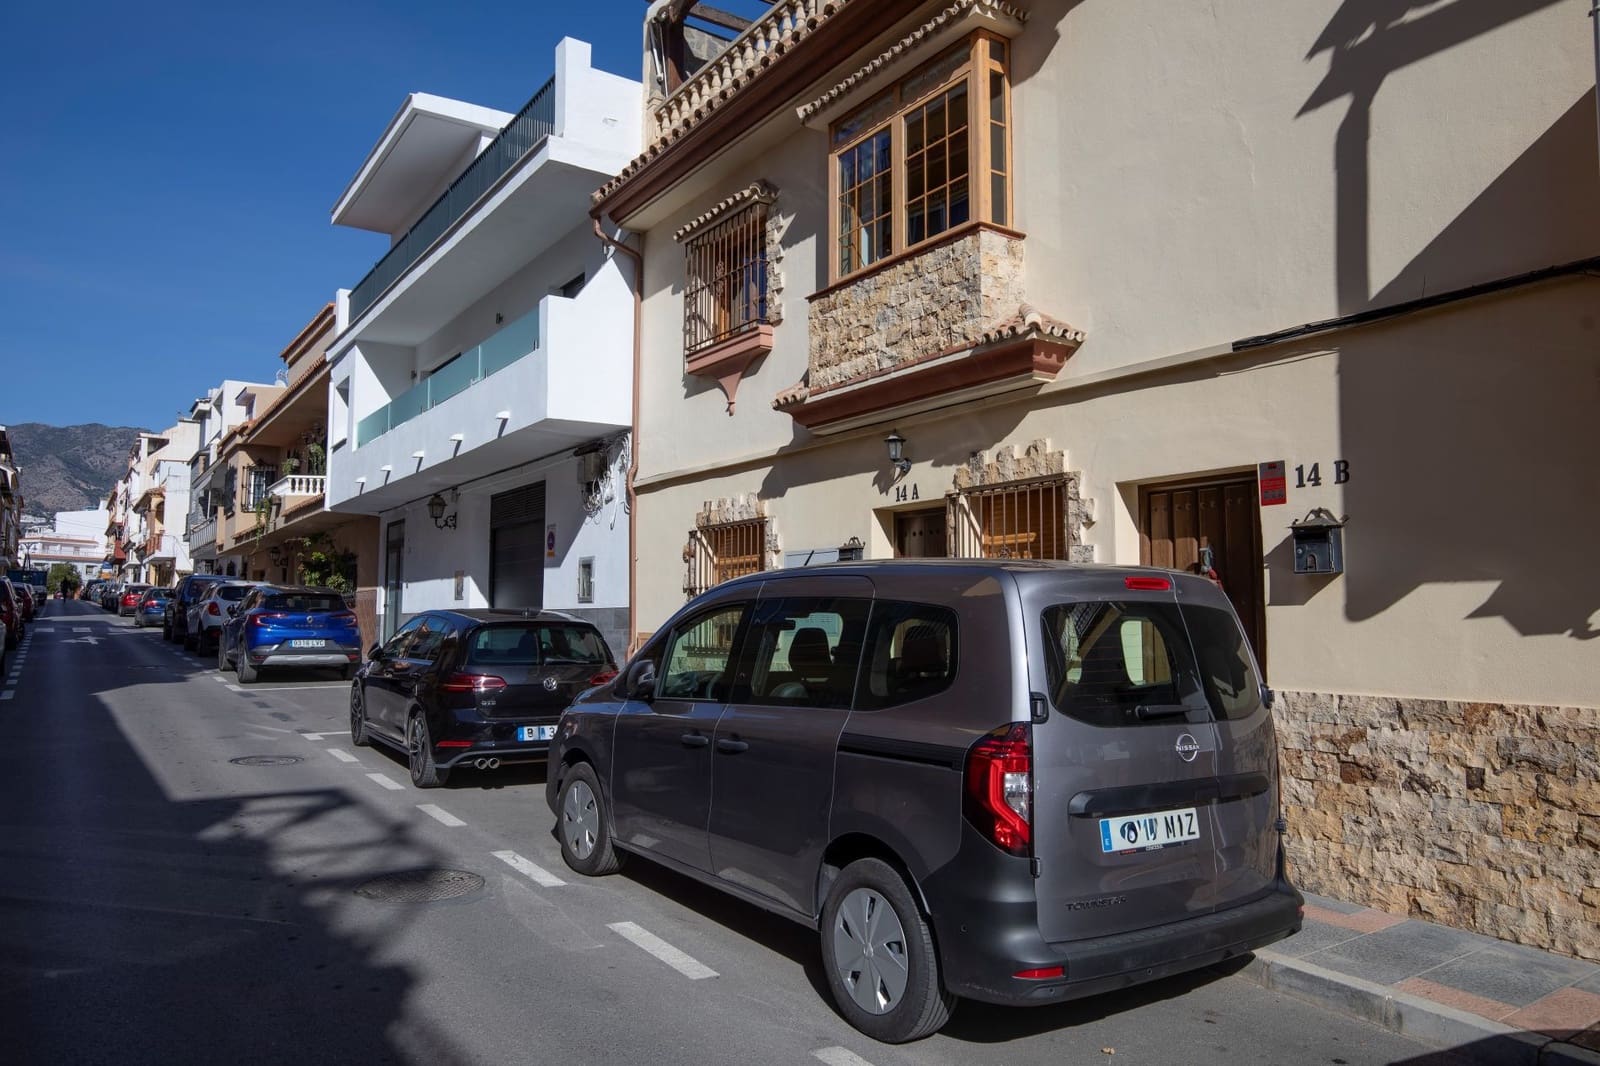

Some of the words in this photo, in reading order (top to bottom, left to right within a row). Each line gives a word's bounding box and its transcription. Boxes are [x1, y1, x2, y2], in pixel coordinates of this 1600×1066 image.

[1295, 462, 1322, 489] 14
[1334, 459, 1350, 485] B
[895, 484, 908, 502] 14
[911, 483, 920, 500] A
[1175, 744, 1200, 752] NISSAN
